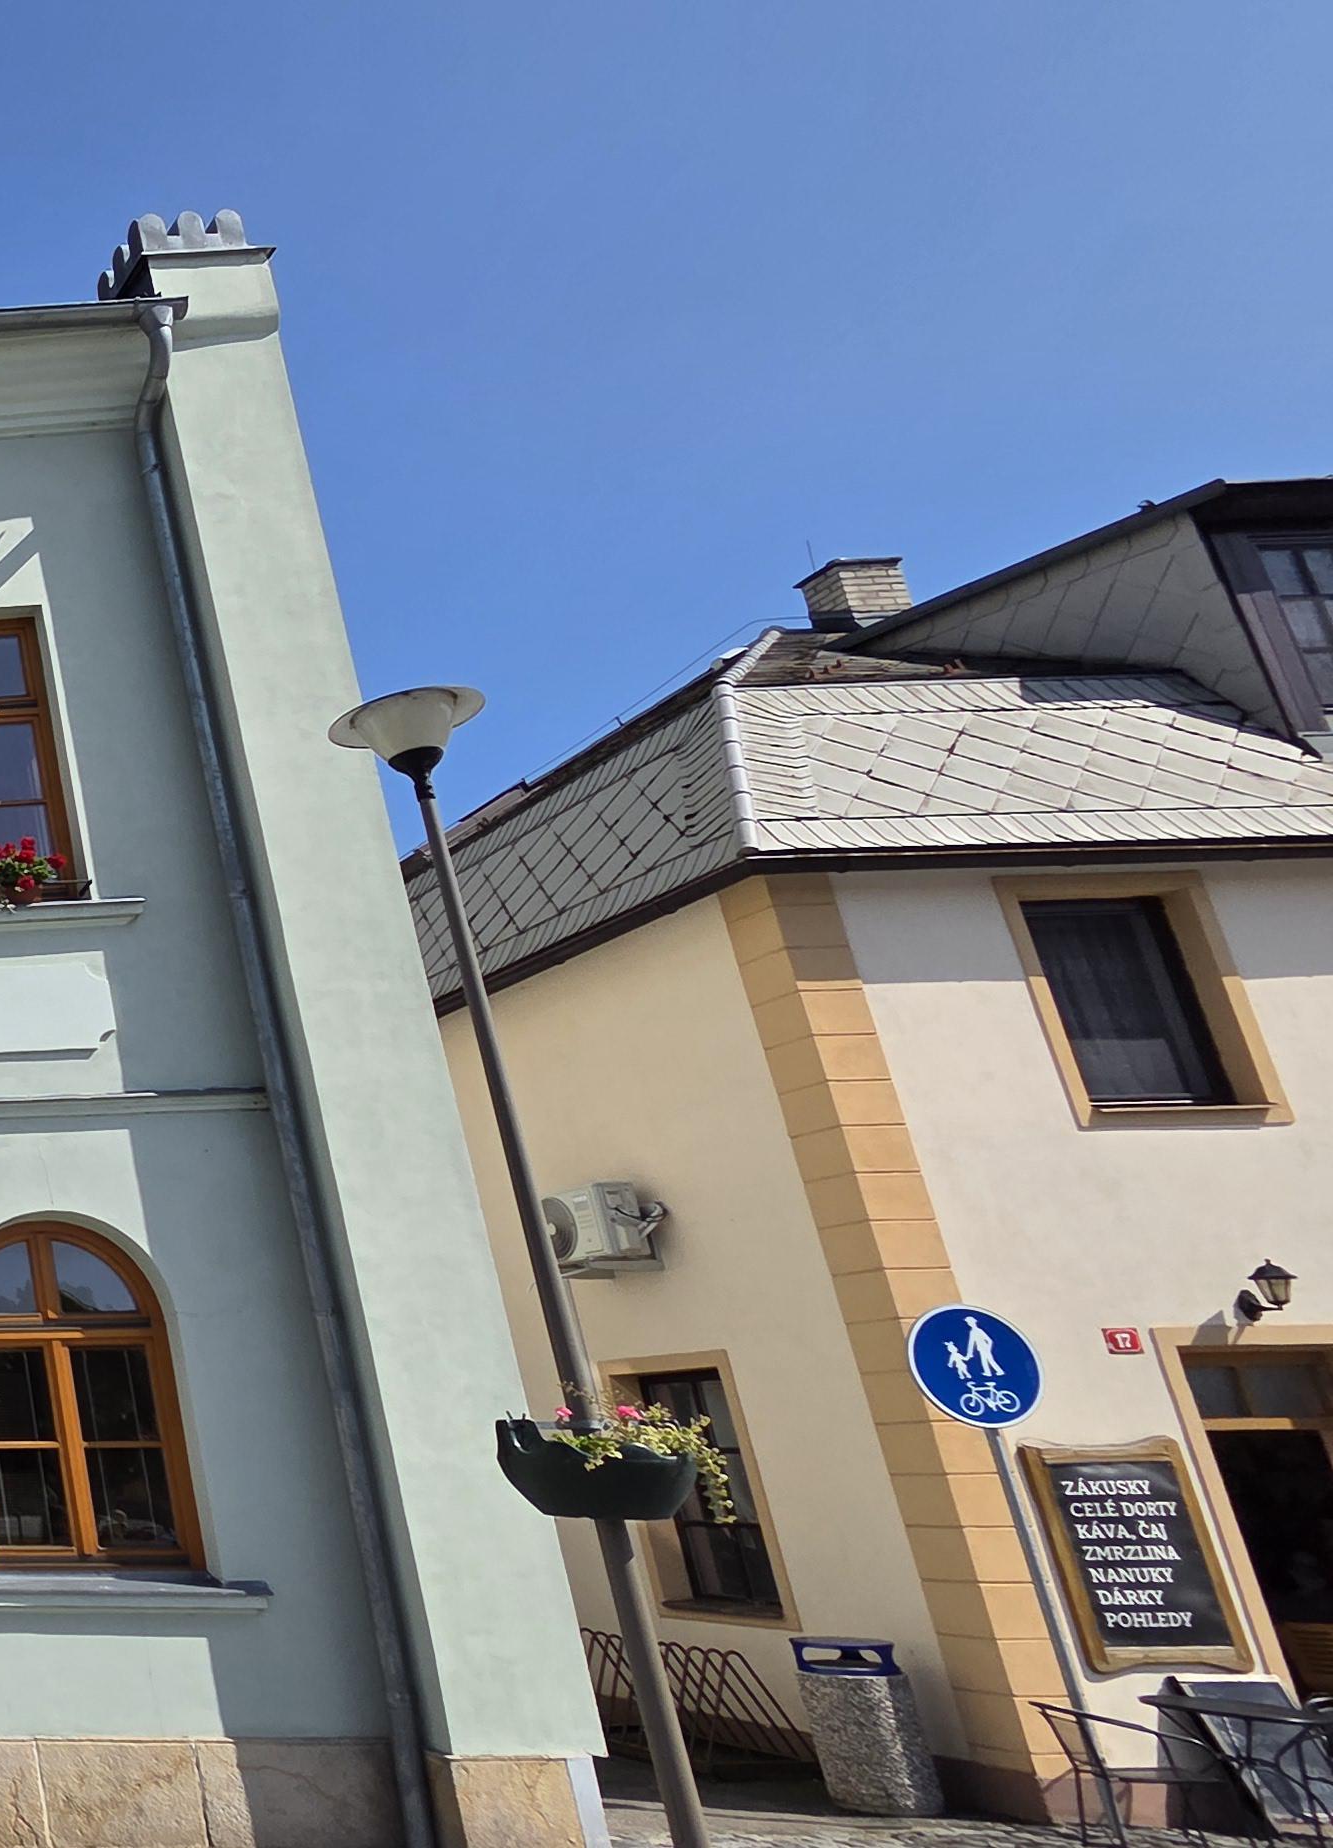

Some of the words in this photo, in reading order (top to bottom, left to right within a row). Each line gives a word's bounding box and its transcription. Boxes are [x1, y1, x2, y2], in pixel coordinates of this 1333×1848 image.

[1114, 1333, 1132, 1348] 17
[1060, 1477, 1151, 1496] ZÁKUSKY
[1069, 1499, 1120, 1518] CELÉ
[1121, 1501, 1178, 1517] DORTY
[1074, 1520, 1137, 1541] KÁVA,
[1137, 1520, 1169, 1541] ČAJ
[1082, 1545, 1182, 1561] ZMRZLINA
[1088, 1567, 1175, 1583] NANUKY
[1095, 1586, 1165, 1606] DÁRKY
[1103, 1611, 1193, 1628] POHLEDY
